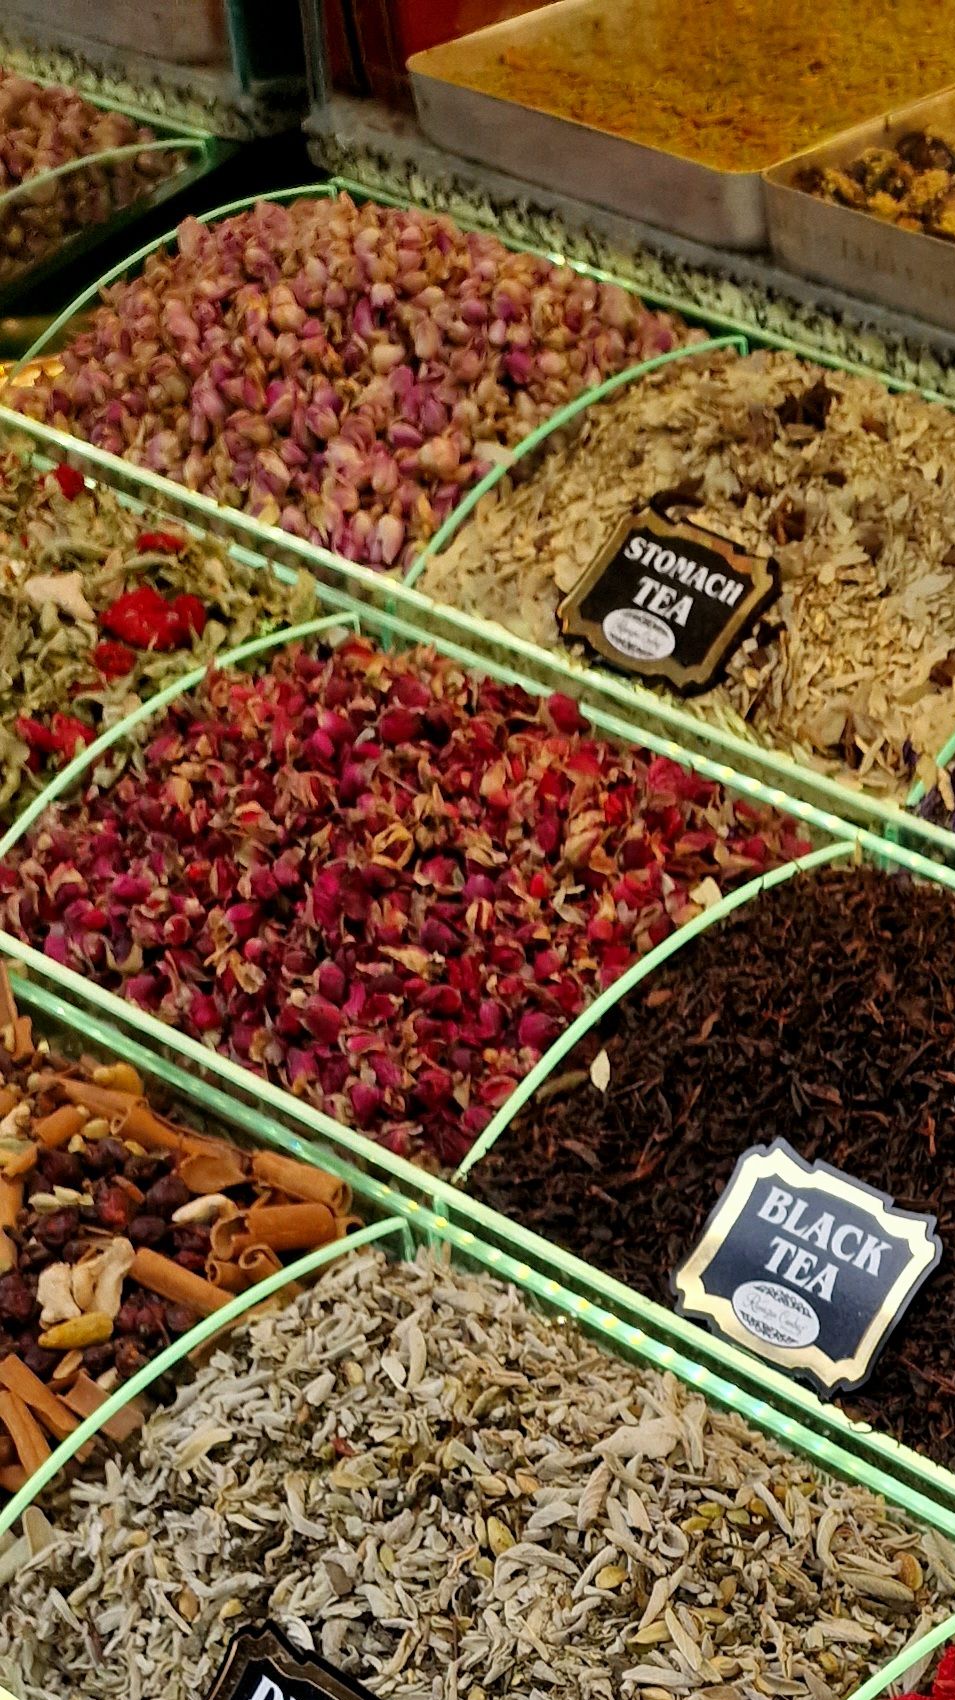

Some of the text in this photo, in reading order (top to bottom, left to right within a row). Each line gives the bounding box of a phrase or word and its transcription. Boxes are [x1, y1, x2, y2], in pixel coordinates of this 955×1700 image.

[623, 536, 744, 608] STOMACH
[632, 575, 695, 627] TEA
[756, 1185, 893, 1277] BLACK
[764, 1236, 840, 1303] TEA
